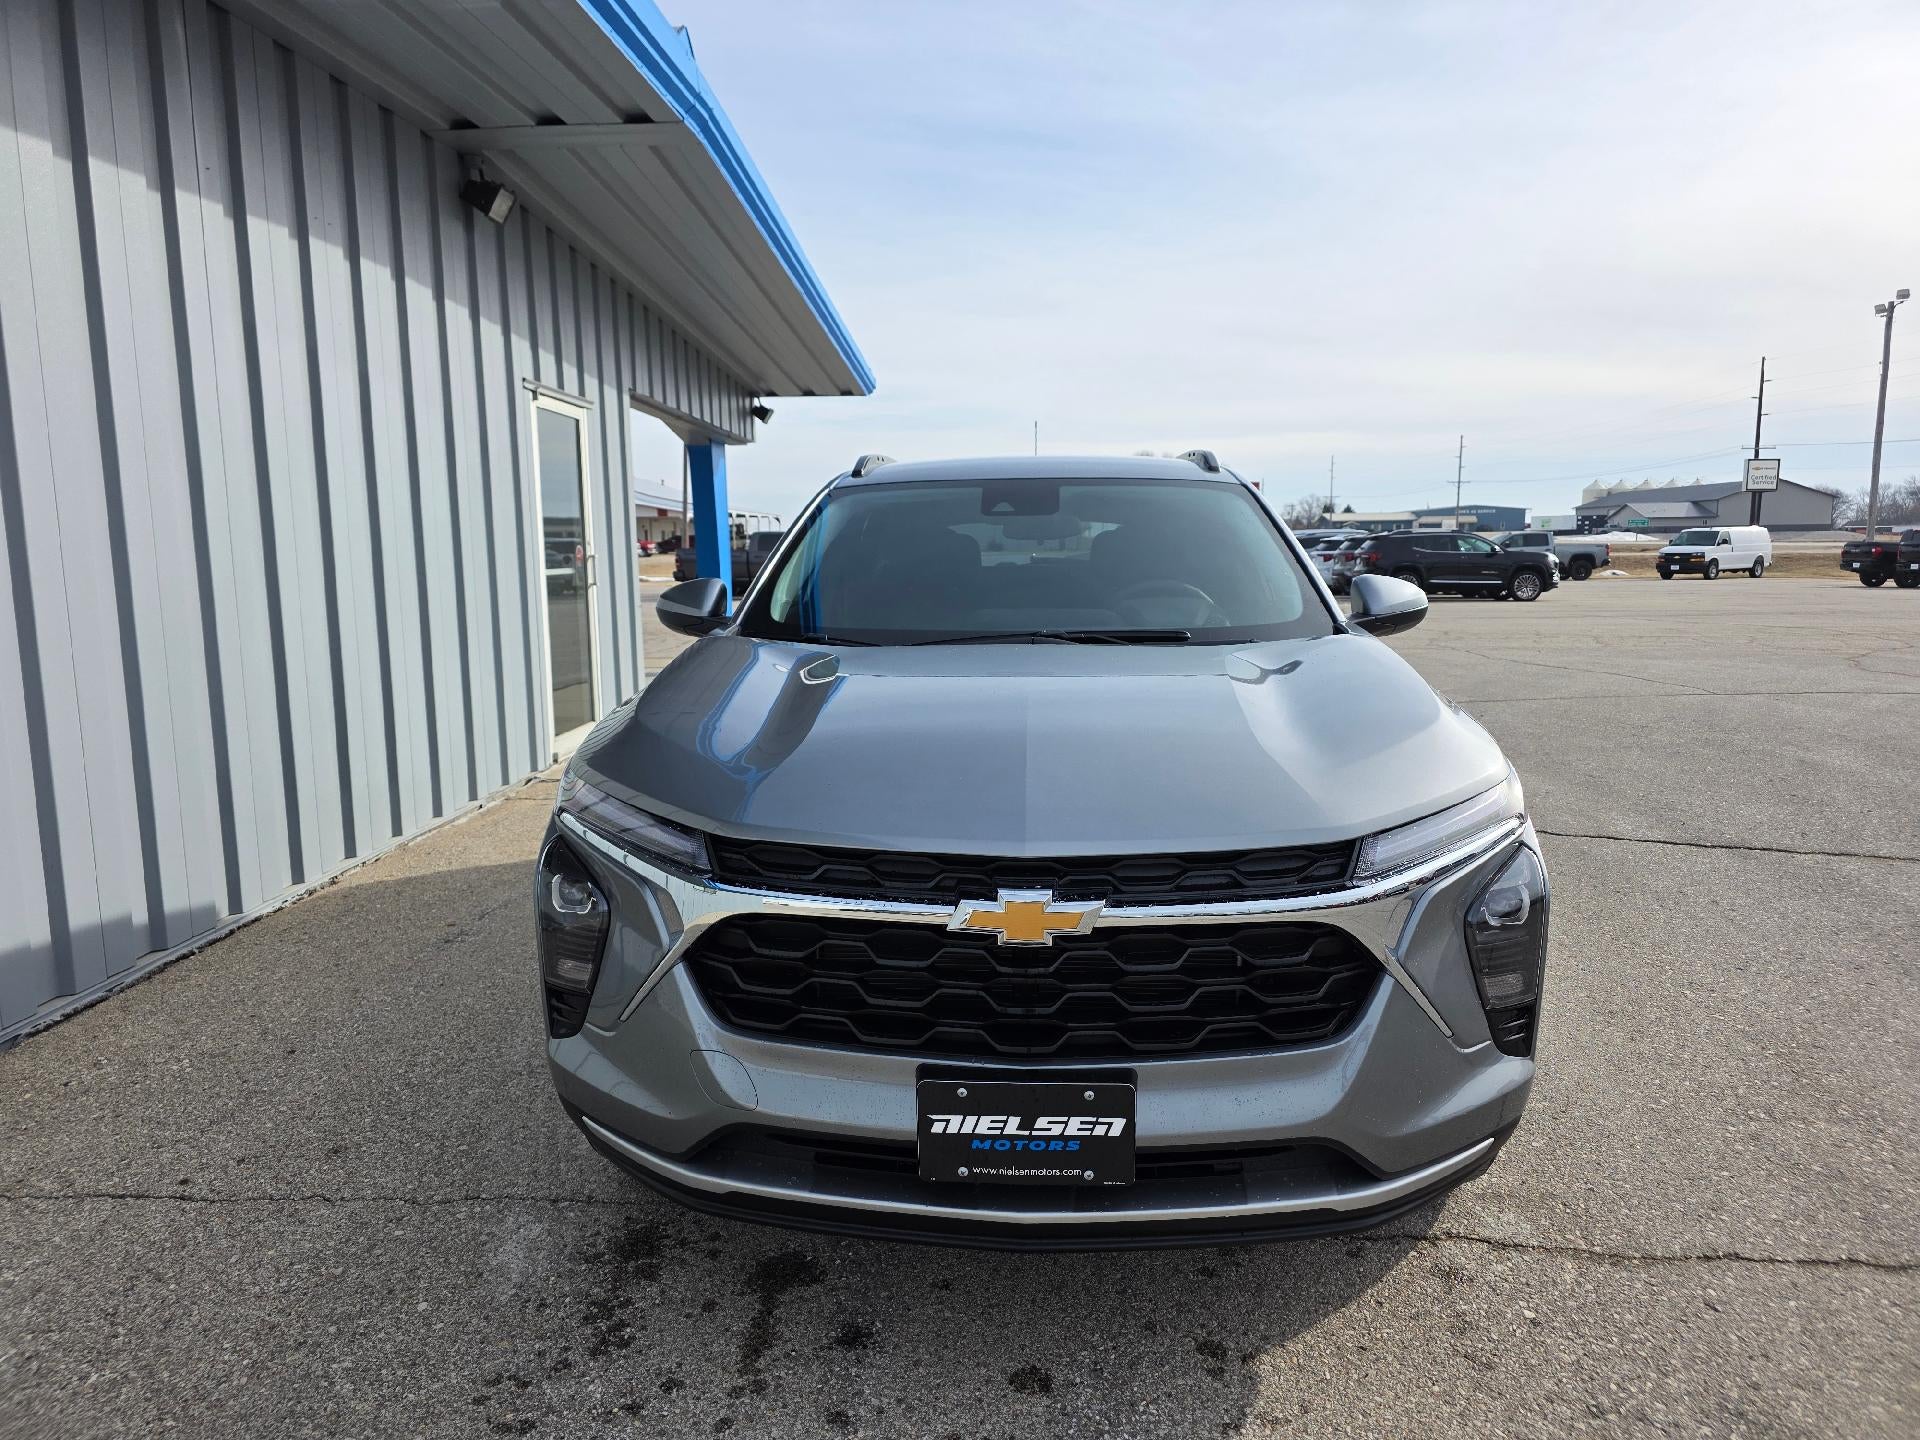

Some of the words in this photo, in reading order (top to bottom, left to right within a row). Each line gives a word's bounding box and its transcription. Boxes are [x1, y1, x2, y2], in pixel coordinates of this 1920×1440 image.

[926, 1114, 1127, 1137] NIELSEN
[971, 1139, 1081, 1152] MOTORS
[972, 1165, 1082, 1177] www.nielsenmotors.com
